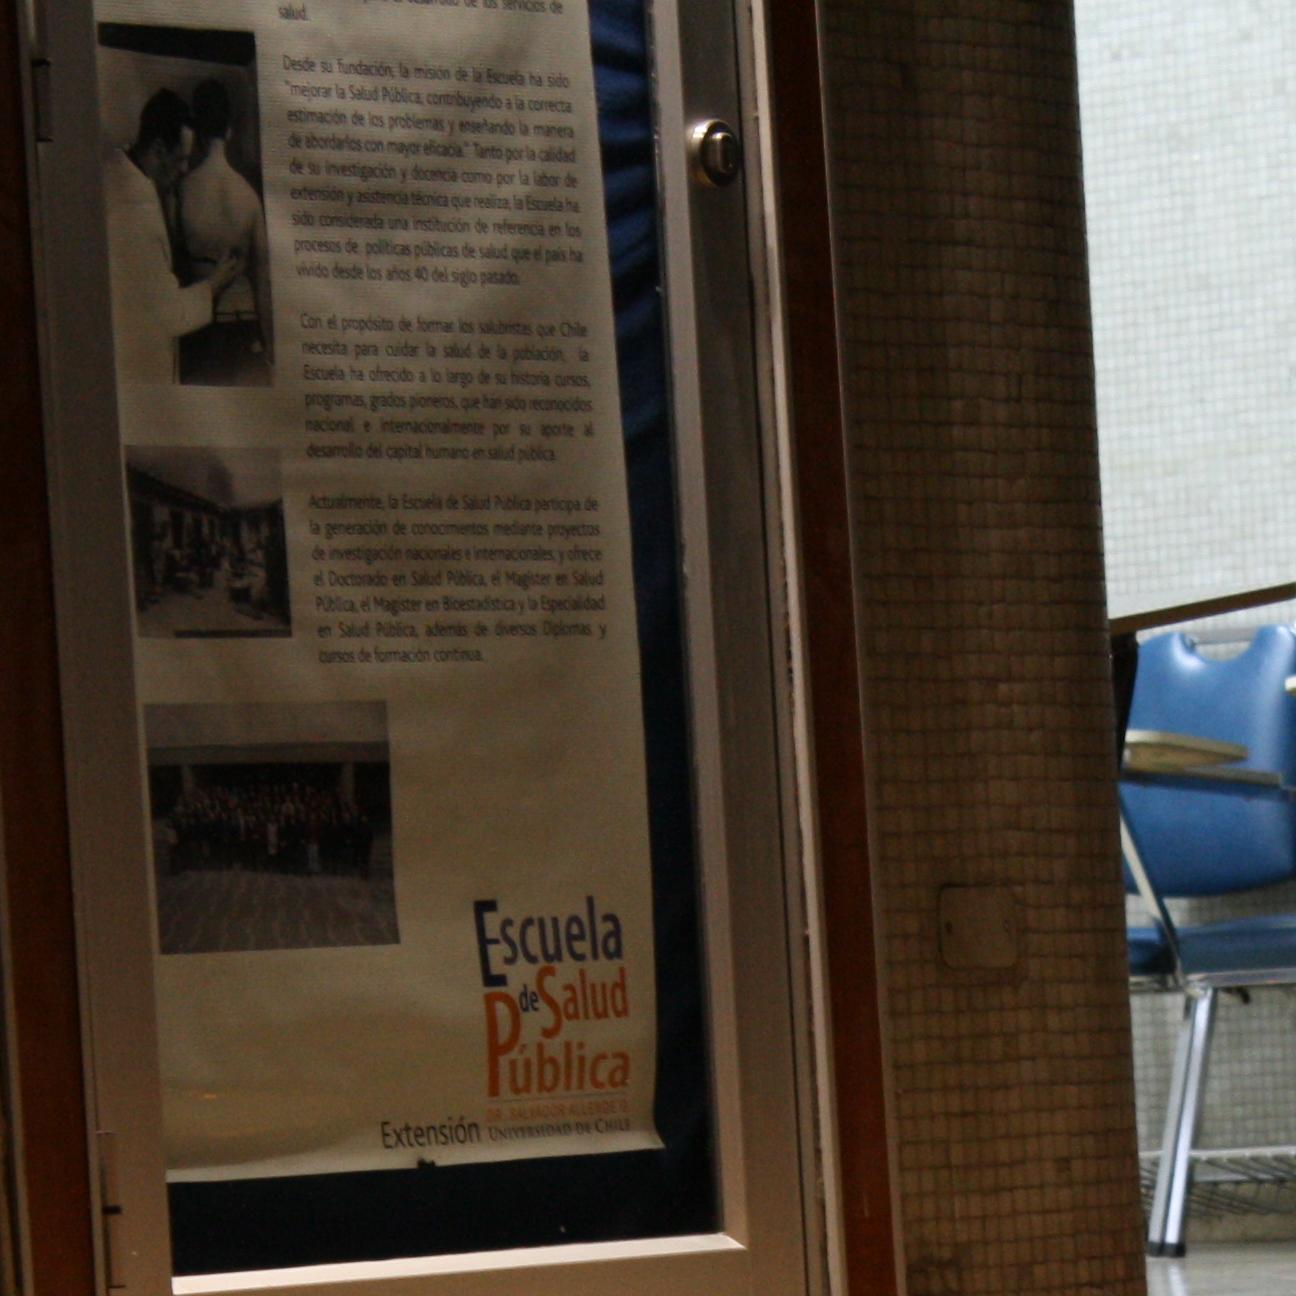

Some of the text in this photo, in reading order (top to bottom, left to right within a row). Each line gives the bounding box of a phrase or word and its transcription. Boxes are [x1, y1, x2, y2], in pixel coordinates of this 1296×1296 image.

[283, 56, 315, 74] Desde
[321, 63, 332, 75] su
[400, 63, 408, 79] la
[414, 65, 450, 81] misión
[456, 66, 468, 82] de
[473, 67, 481, 83] la
[486, 67, 524, 85] Escuela
[530, 70, 542, 86] ha
[548, 71, 569, 88] sido
[336, 83, 345, 99] la
[350, 84, 377, 101] Salud
[506, 97, 512, 109] a
[516, 94, 524, 110] la
[529, 95, 572, 113] correcta
[352, 110, 364, 126] de
[369, 111, 384, 128] los
[389, 112, 444, 136] problemas
[448, 119, 454, 136] y
[520, 119, 528, 135] la
[534, 124, 574, 138] manera
[289, 132, 301, 149] de
[365, 140, 384, 153] con
[388, 142, 420, 160] mayor
[506, 147, 522, 165] por
[527, 145, 535, 160] la
[289, 158, 302, 175] de
[309, 163, 320, 175] su
[401, 168, 407, 184] y
[462, 170, 492, 183] como
[497, 172, 514, 189] por
[520, 169, 529, 185] la
[565, 171, 576, 187] de
[292, 210, 313, 226] sido
[475, 218, 488, 234] de
[549, 225, 561, 237] en
[566, 221, 580, 238] los
[295, 240, 341, 258] procesos
[345, 238, 358, 254] de
[462, 242, 475, 258] de
[333, 263, 363, 280] desde
[367, 264, 382, 280] los
[432, 267, 448, 283] del
[452, 267, 477, 289] siglo
[301, 312, 321, 329] Con
[328, 313, 336, 329] el
[399, 315, 412, 331] de
[459, 317, 473, 333] los
[560, 320, 586, 336] Chile
[355, 343, 377, 361] para
[426, 341, 435, 357] la
[444, 342, 470, 358] salud
[478, 343, 490, 359] de
[498, 343, 506, 359] la
[304, 364, 345, 380] Escuela
[351, 365, 363, 381] ha
[419, 371, 426, 382] a
[431, 367, 441, 383] lo
[447, 367, 473, 389] largo
[478, 368, 489, 384] de
[493, 423, 509, 440] por
[474, 895, 623, 987] Escuela
[519, 965, 629, 1039] de Salud
[483, 990, 631, 1097] Pública
[381, 1115, 481, 1149] Extensión
